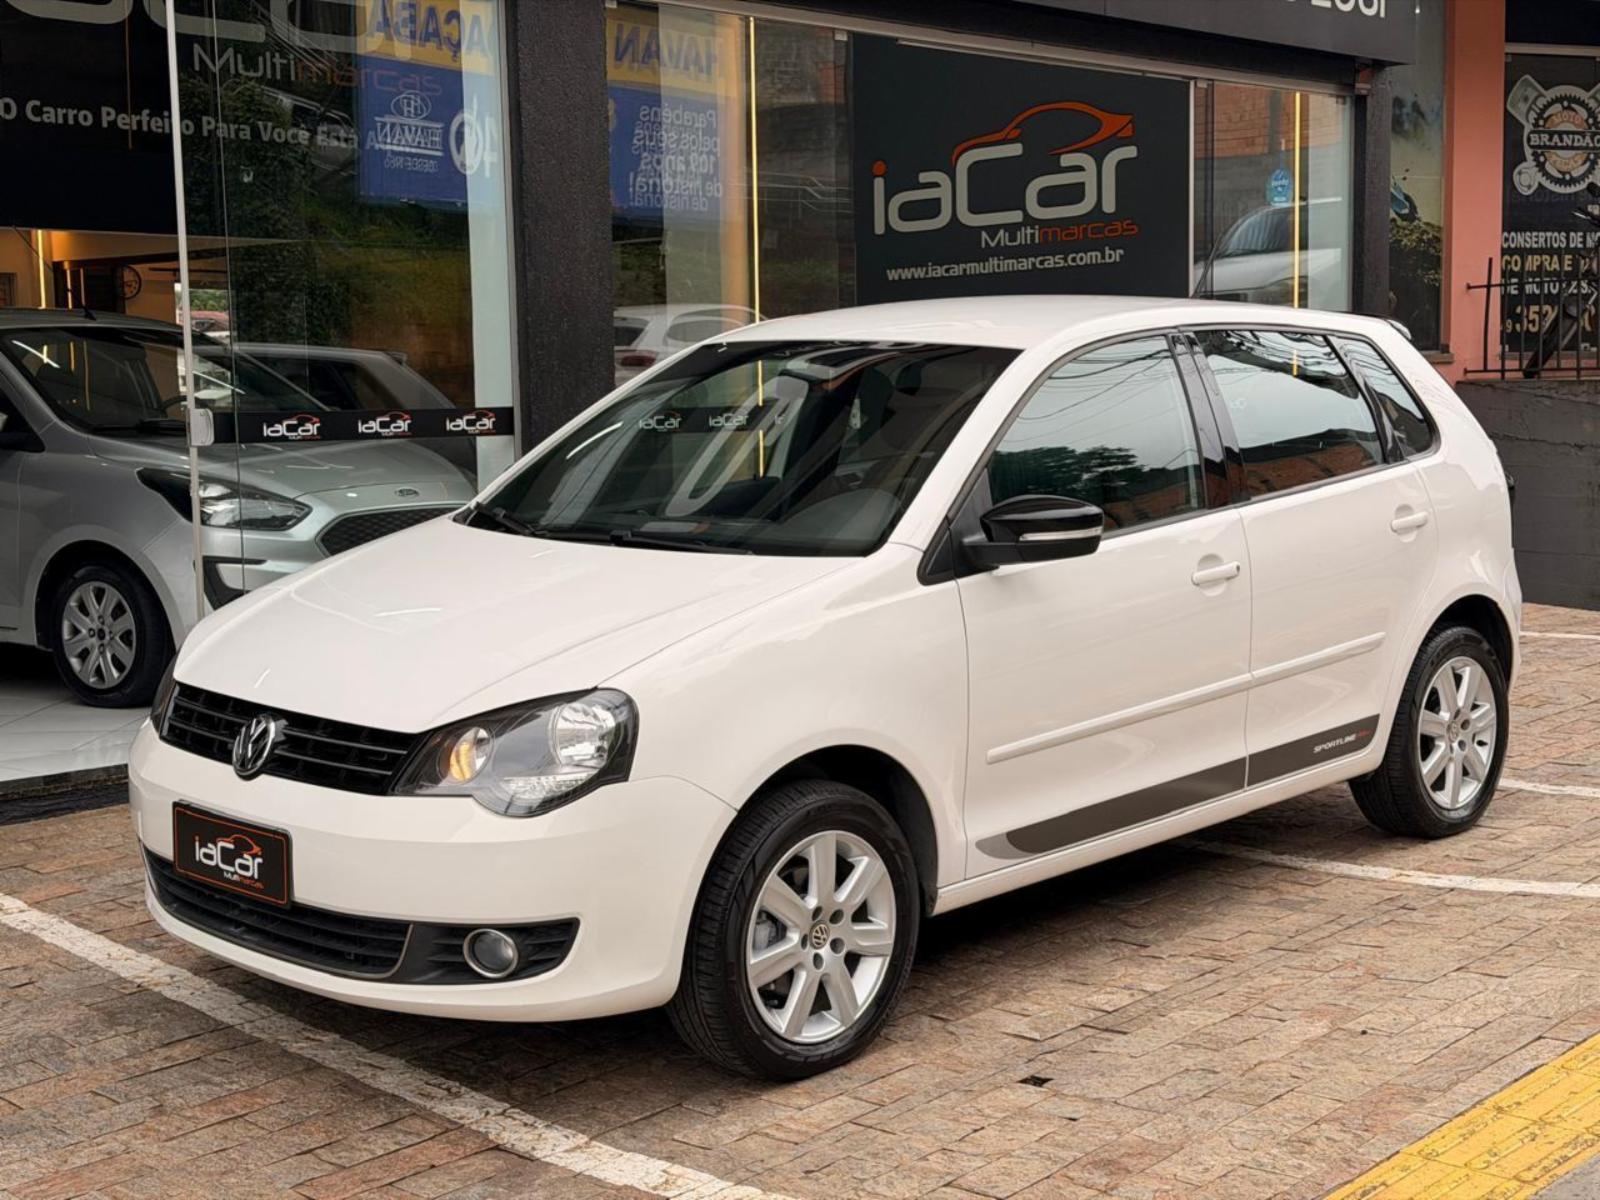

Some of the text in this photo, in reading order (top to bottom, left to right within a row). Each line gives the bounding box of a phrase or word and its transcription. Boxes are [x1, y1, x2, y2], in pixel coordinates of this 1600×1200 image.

[25, 99, 94, 127] Carro
[101, 106, 195, 136] Perfeio
[202, 115, 252, 140] Para
[872, 142, 1138, 235] iaCar
[981, 219, 1138, 249] Multimarcas
[1502, 231, 1567, 248] CONSERTOS
[1569, 231, 1584, 248] DE
[886, 245, 1125, 282] www.iacarmultimarcas.com.br
[194, 835, 264, 880] iaCar
